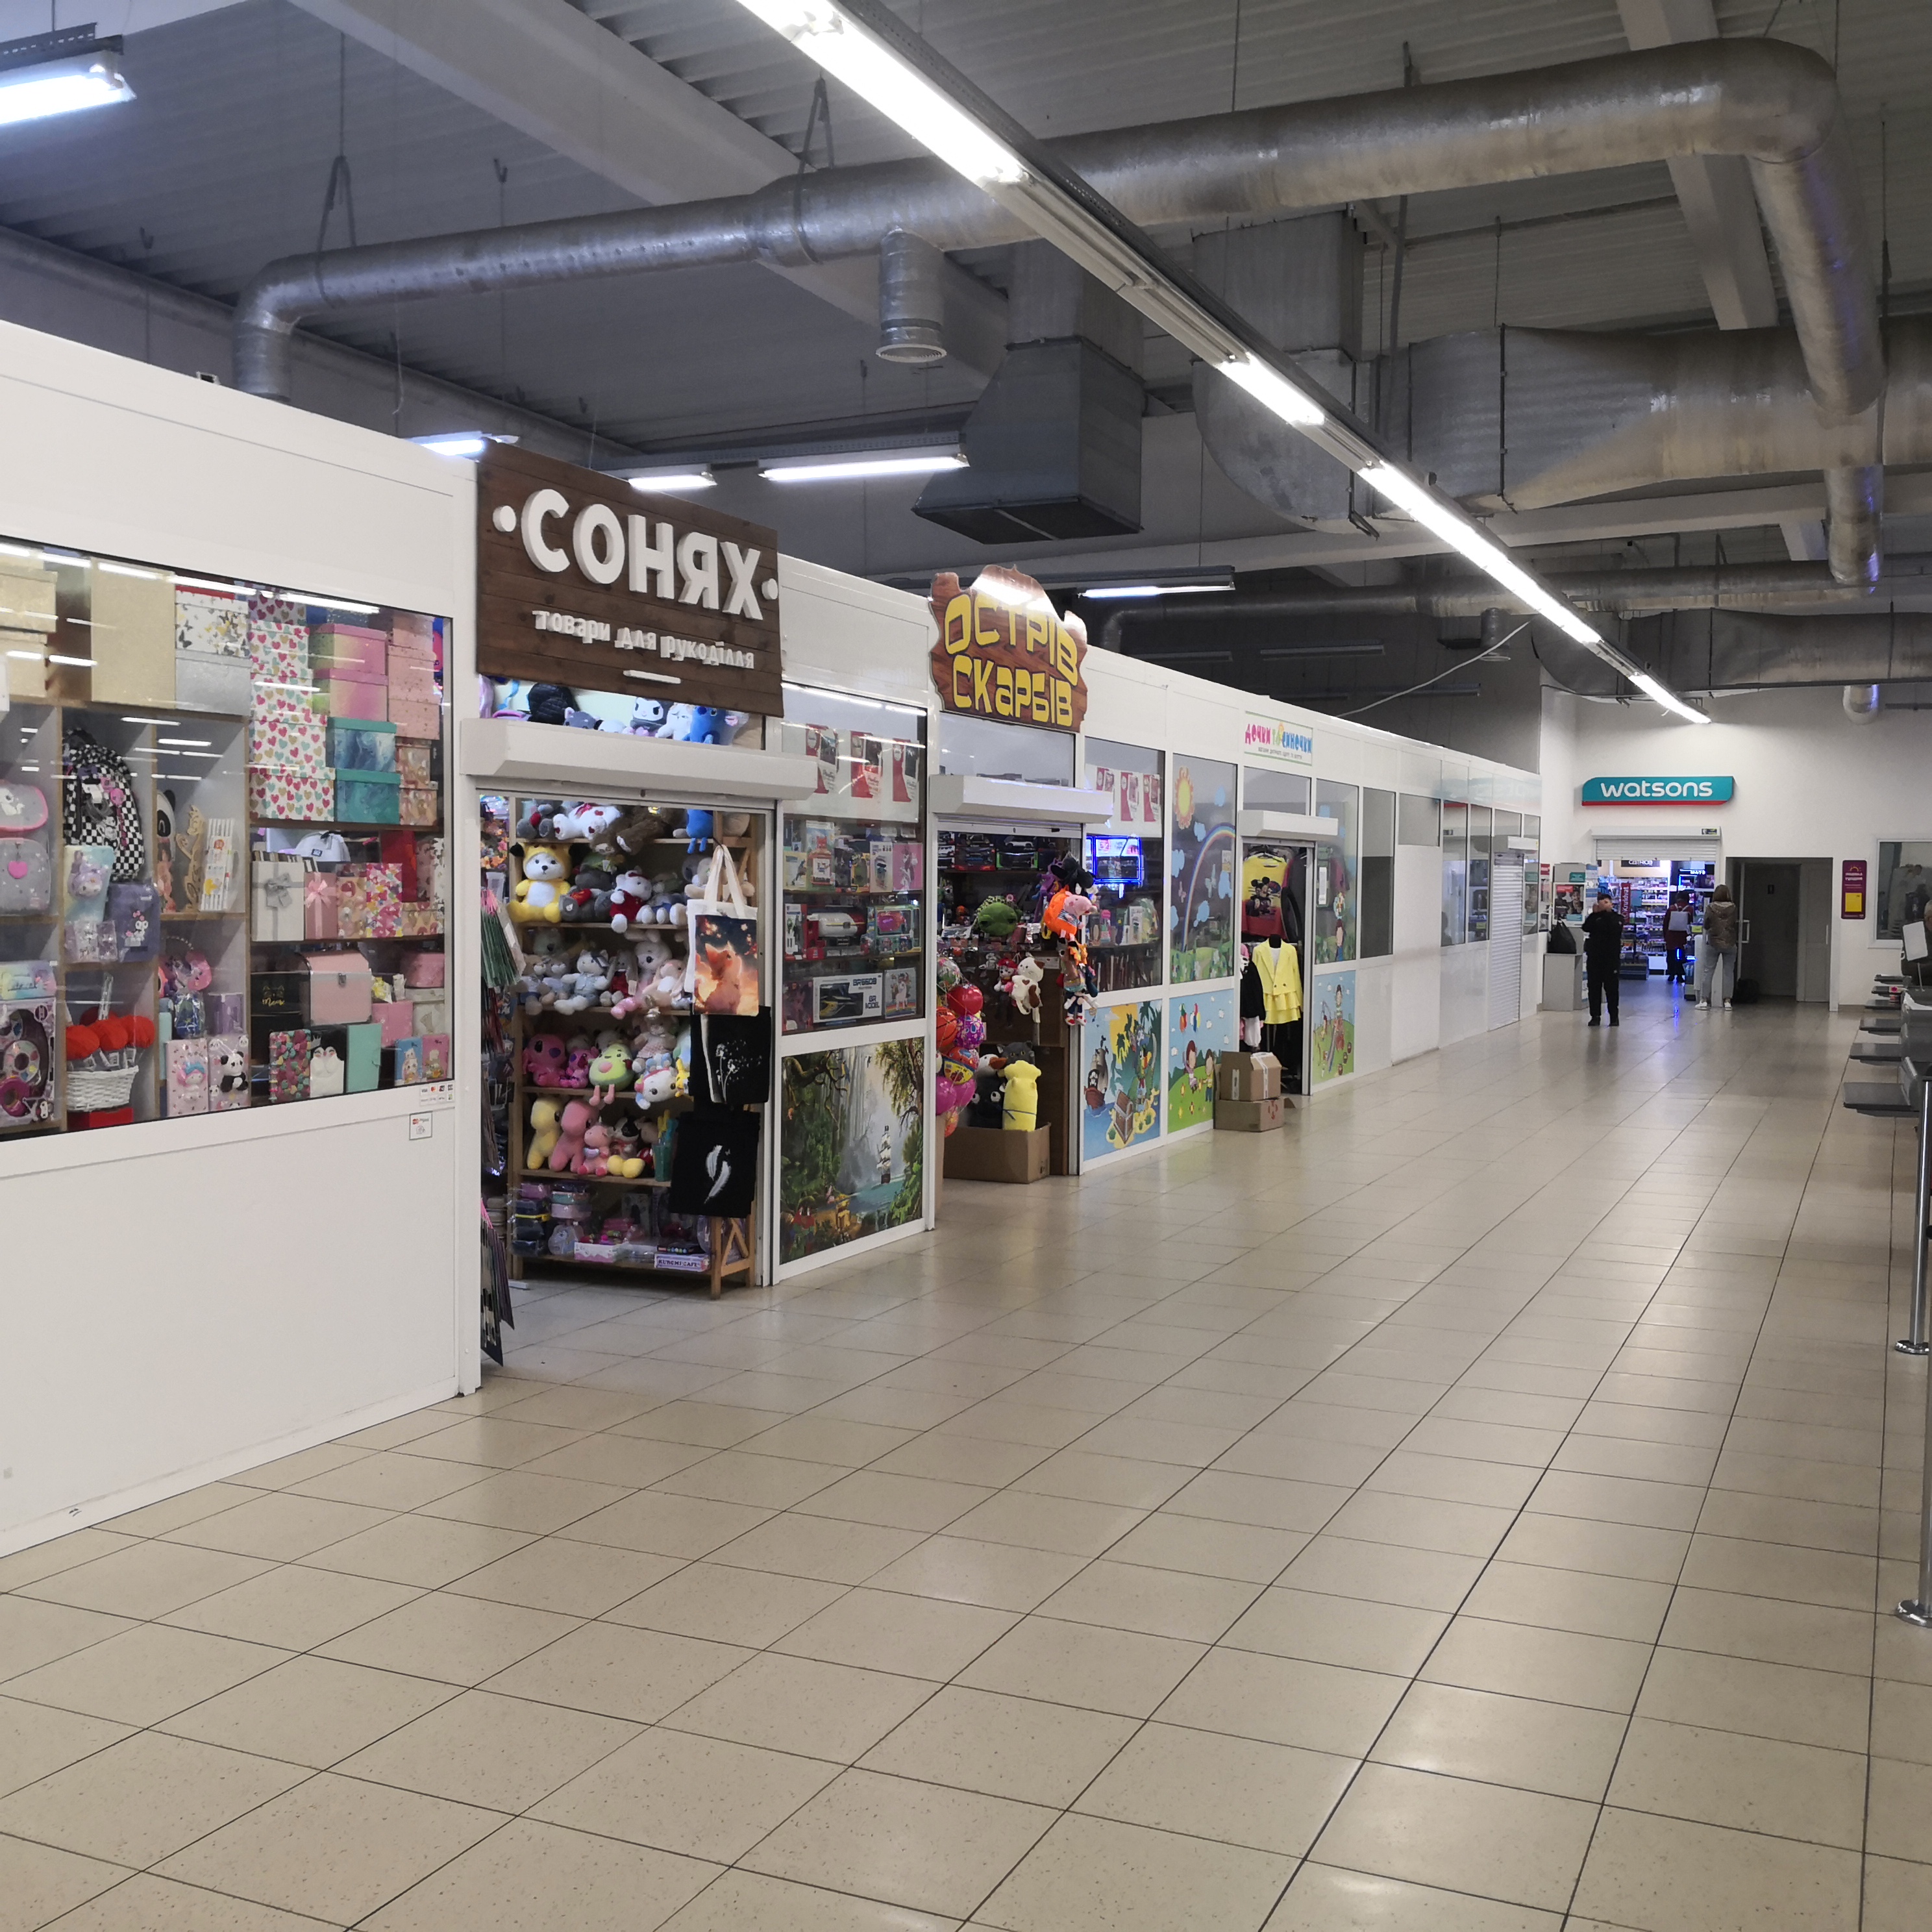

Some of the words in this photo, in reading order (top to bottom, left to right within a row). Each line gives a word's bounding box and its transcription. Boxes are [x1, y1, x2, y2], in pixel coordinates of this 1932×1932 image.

[521, 488, 763, 621] СОНЯХ
[532, 610, 611, 644] товари
[614, 627, 657, 650] для
[660, 636, 755, 669] рукоділля
[945, 593, 1078, 686] ОСТРІВ
[1600, 780, 1713, 798] watsons
